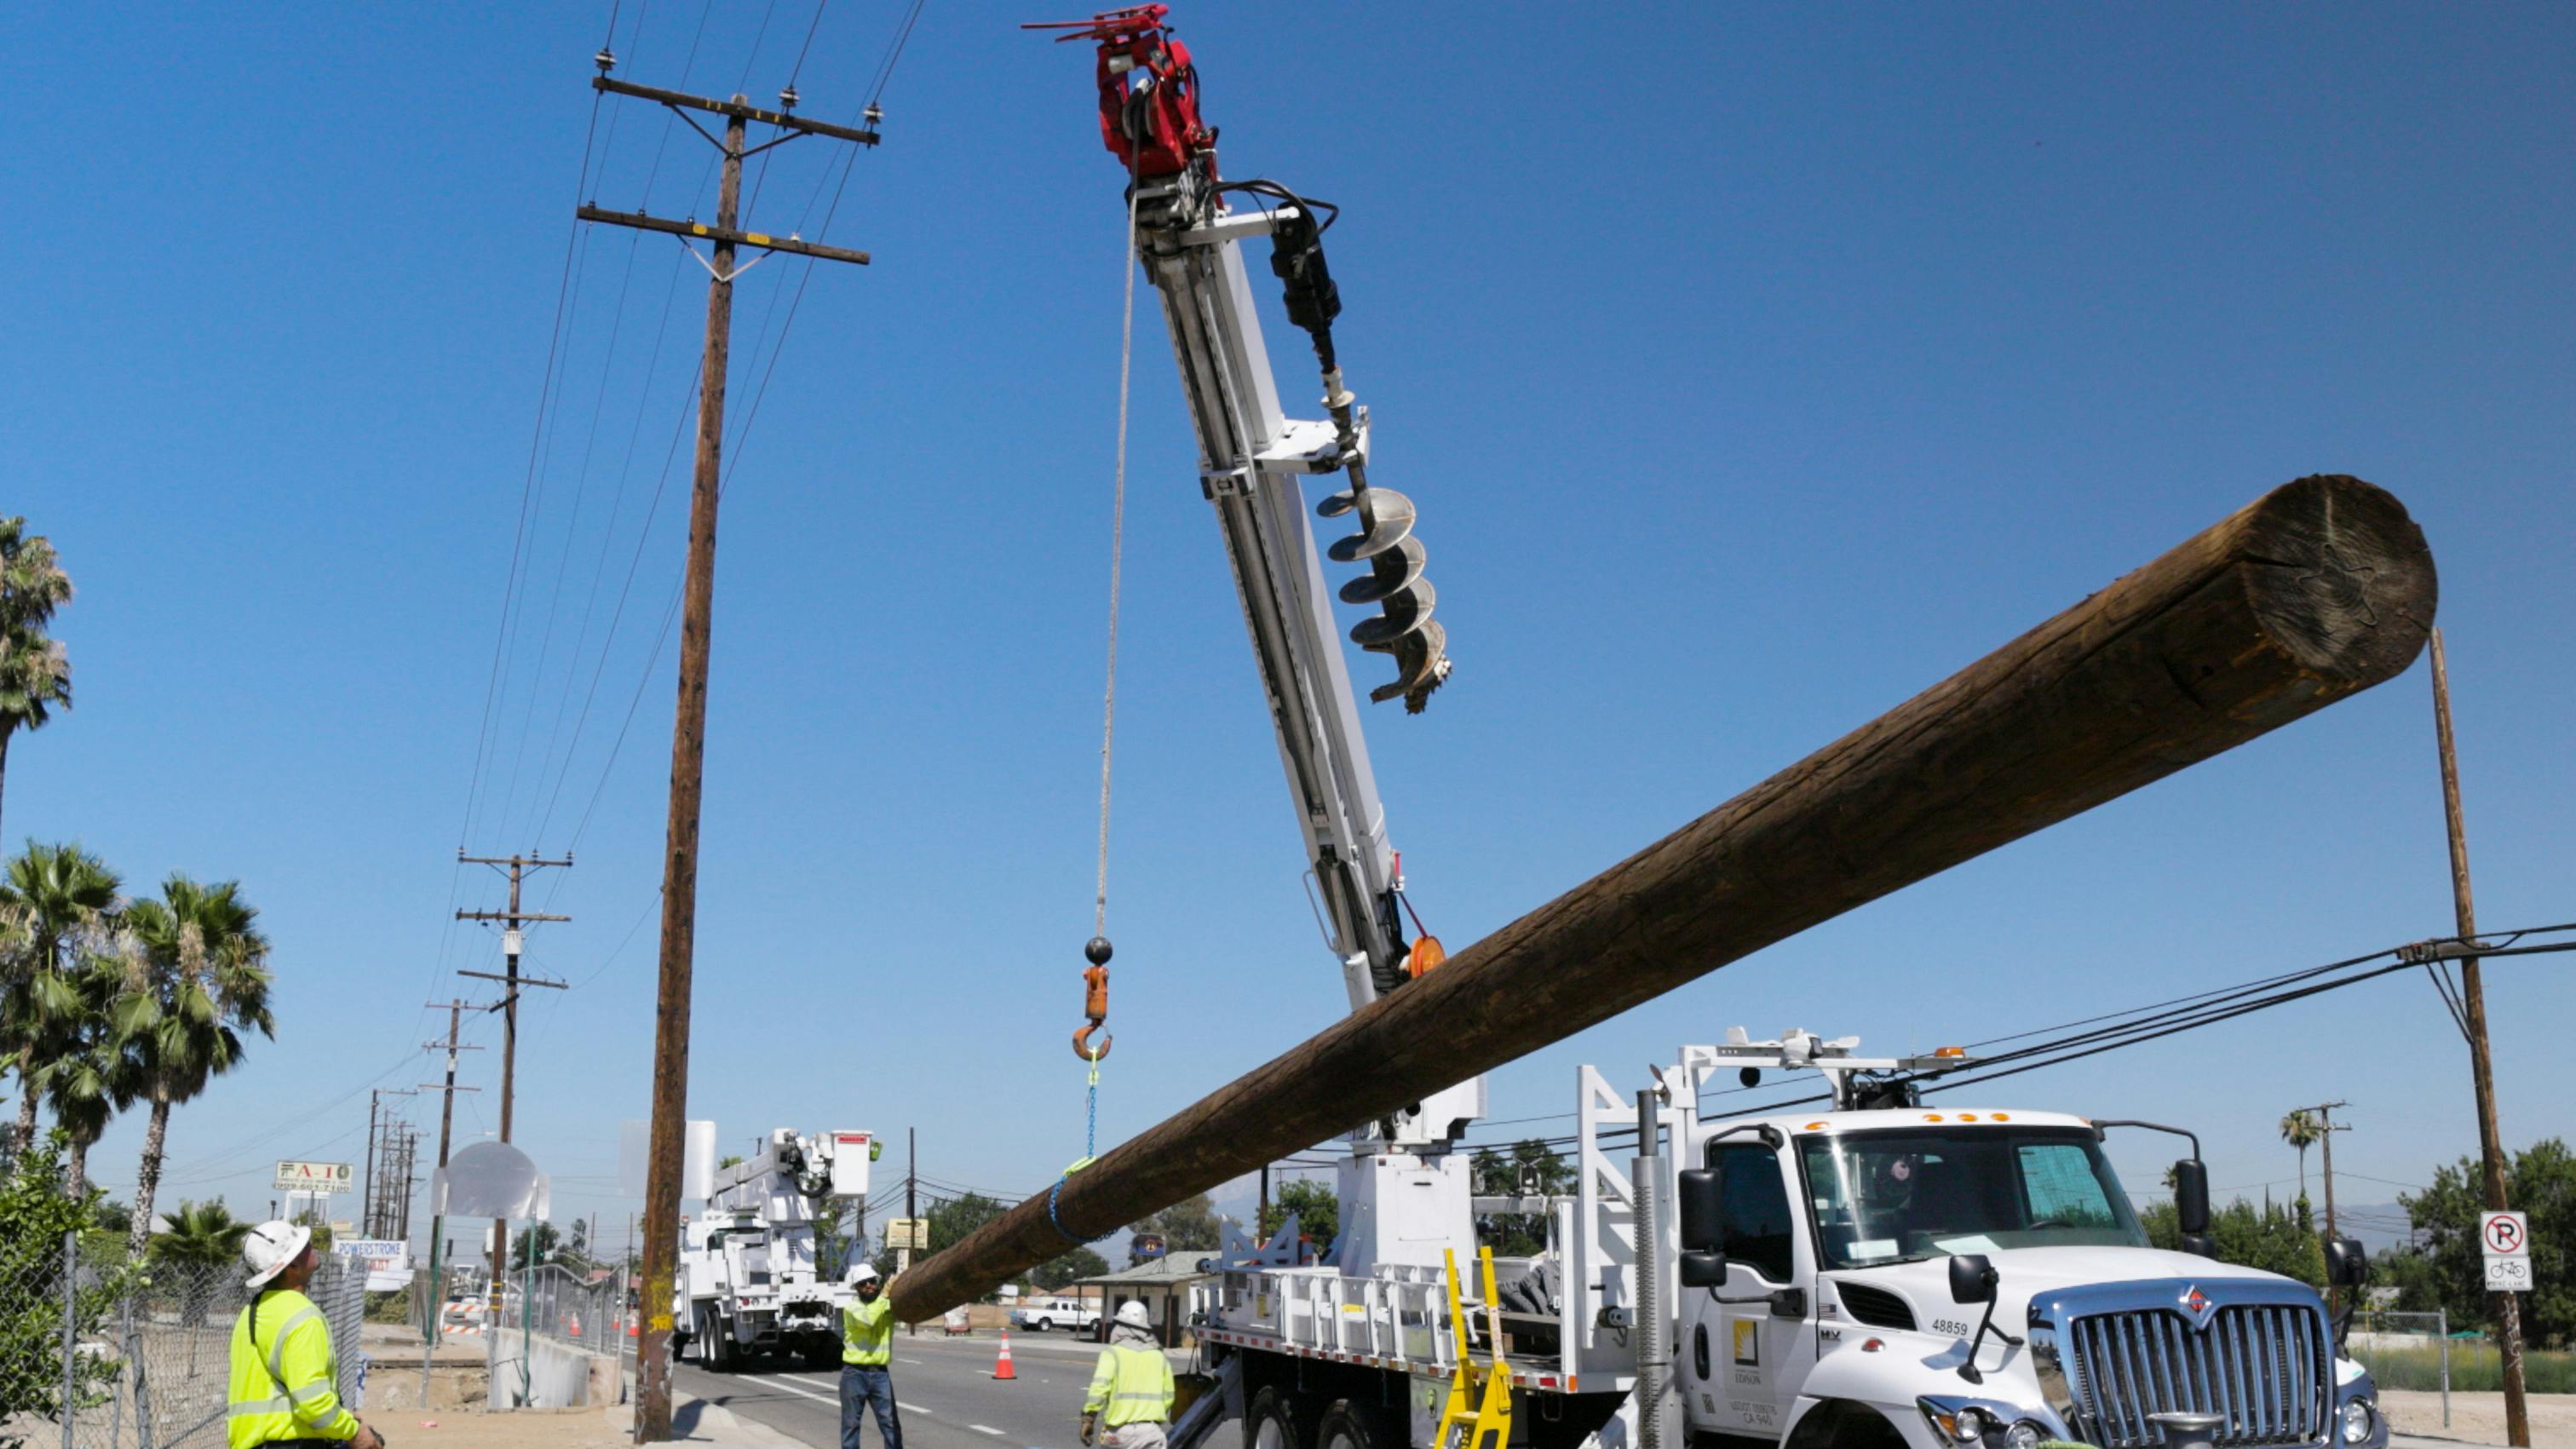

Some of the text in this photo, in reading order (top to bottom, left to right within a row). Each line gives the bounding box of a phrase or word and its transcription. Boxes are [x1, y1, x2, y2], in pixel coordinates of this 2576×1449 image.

[339, 1243, 400, 1255] POWERSTROKE
[1932, 1319, 1968, 1336] 48859
[1735, 1373, 1761, 1385] EDISON
